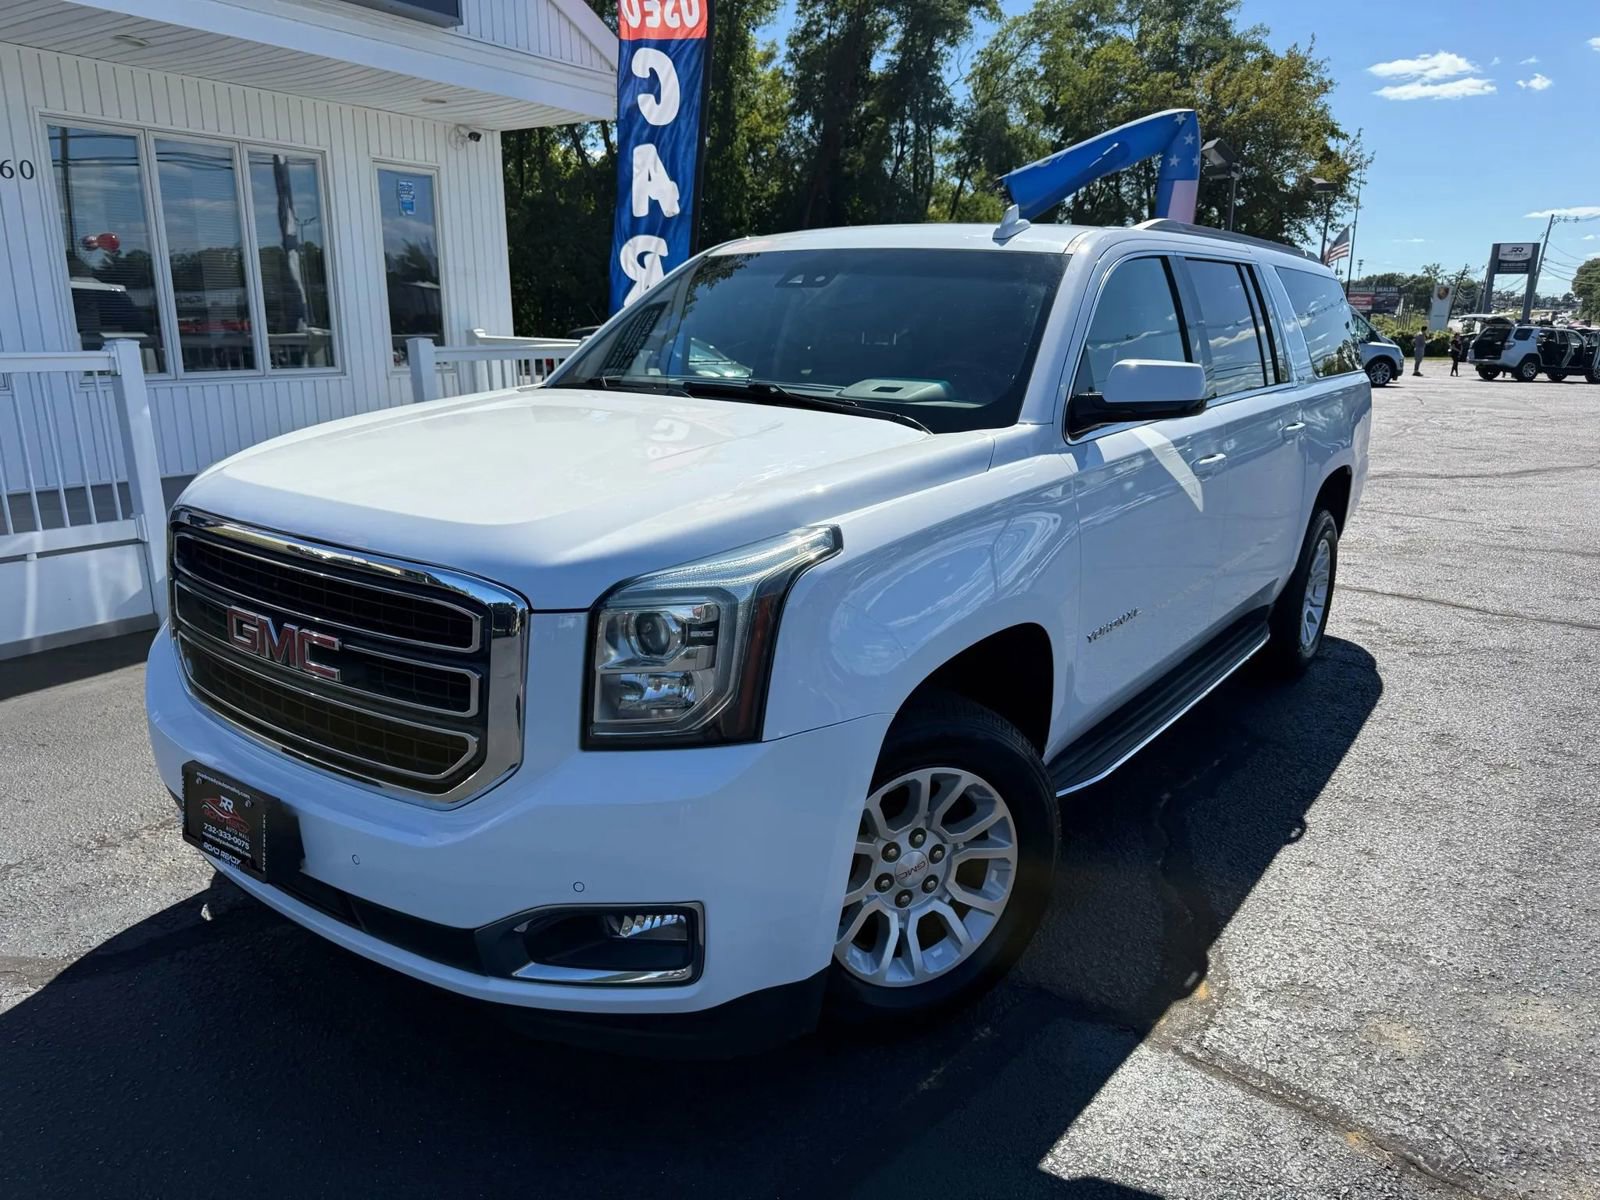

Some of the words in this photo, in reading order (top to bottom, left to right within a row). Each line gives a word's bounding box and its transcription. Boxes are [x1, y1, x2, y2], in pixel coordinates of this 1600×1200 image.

[0, 159, 35, 180] 60
[227, 605, 342, 682] GMC
[895, 860, 926, 881] GMC
